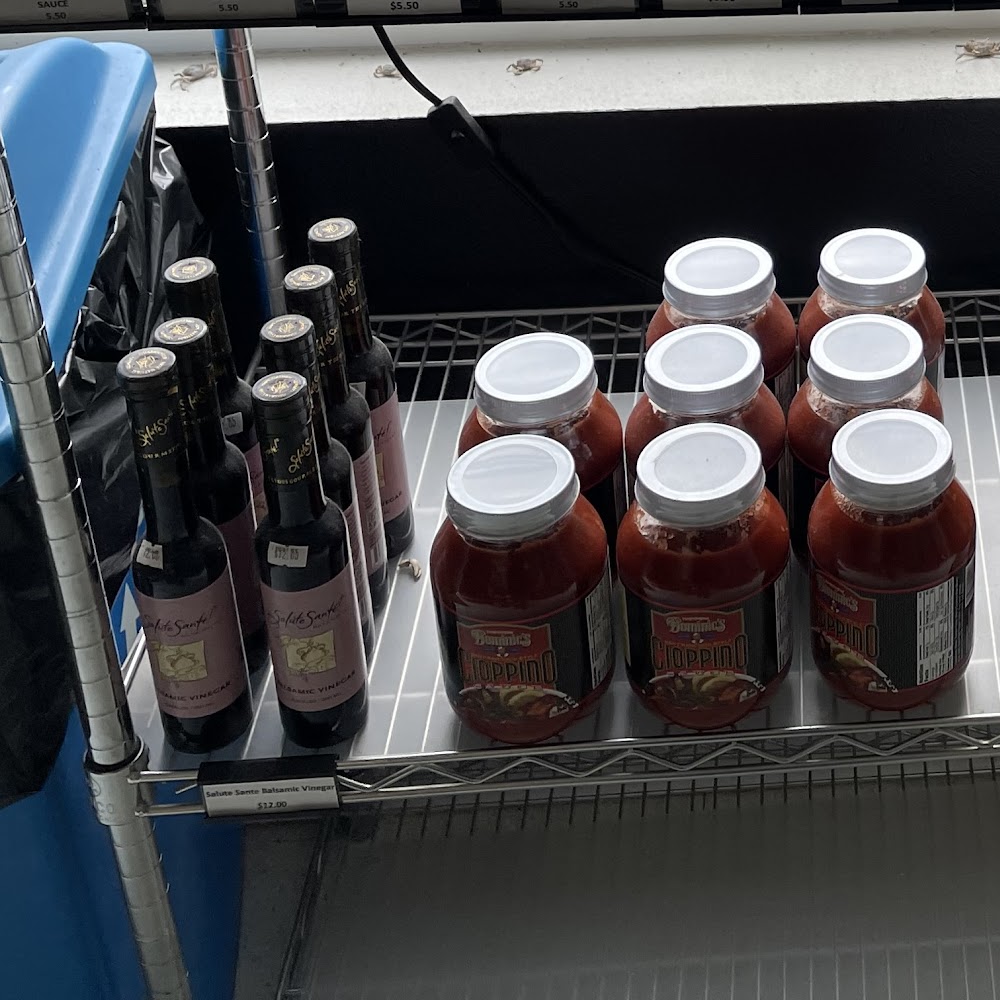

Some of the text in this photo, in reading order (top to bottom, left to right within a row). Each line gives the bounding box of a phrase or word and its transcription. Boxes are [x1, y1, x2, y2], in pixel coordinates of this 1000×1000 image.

[37, 0, 69, 9] SAUCE
[218, 4, 239, 12] 5.50
[390, 0, 419, 11] $5.50
[559, 1, 579, 9] 5.50
[45, 12, 67, 20] 5.50
[666, 616, 726, 633] Dominic's
[651, 634, 748, 671] CIOPPINO
[189, 680, 231, 701] VINEGAR
[206, 784, 335, 798] Salute Sante Balsamic Vinegar
[257, 801, 287, 811] $12.00
